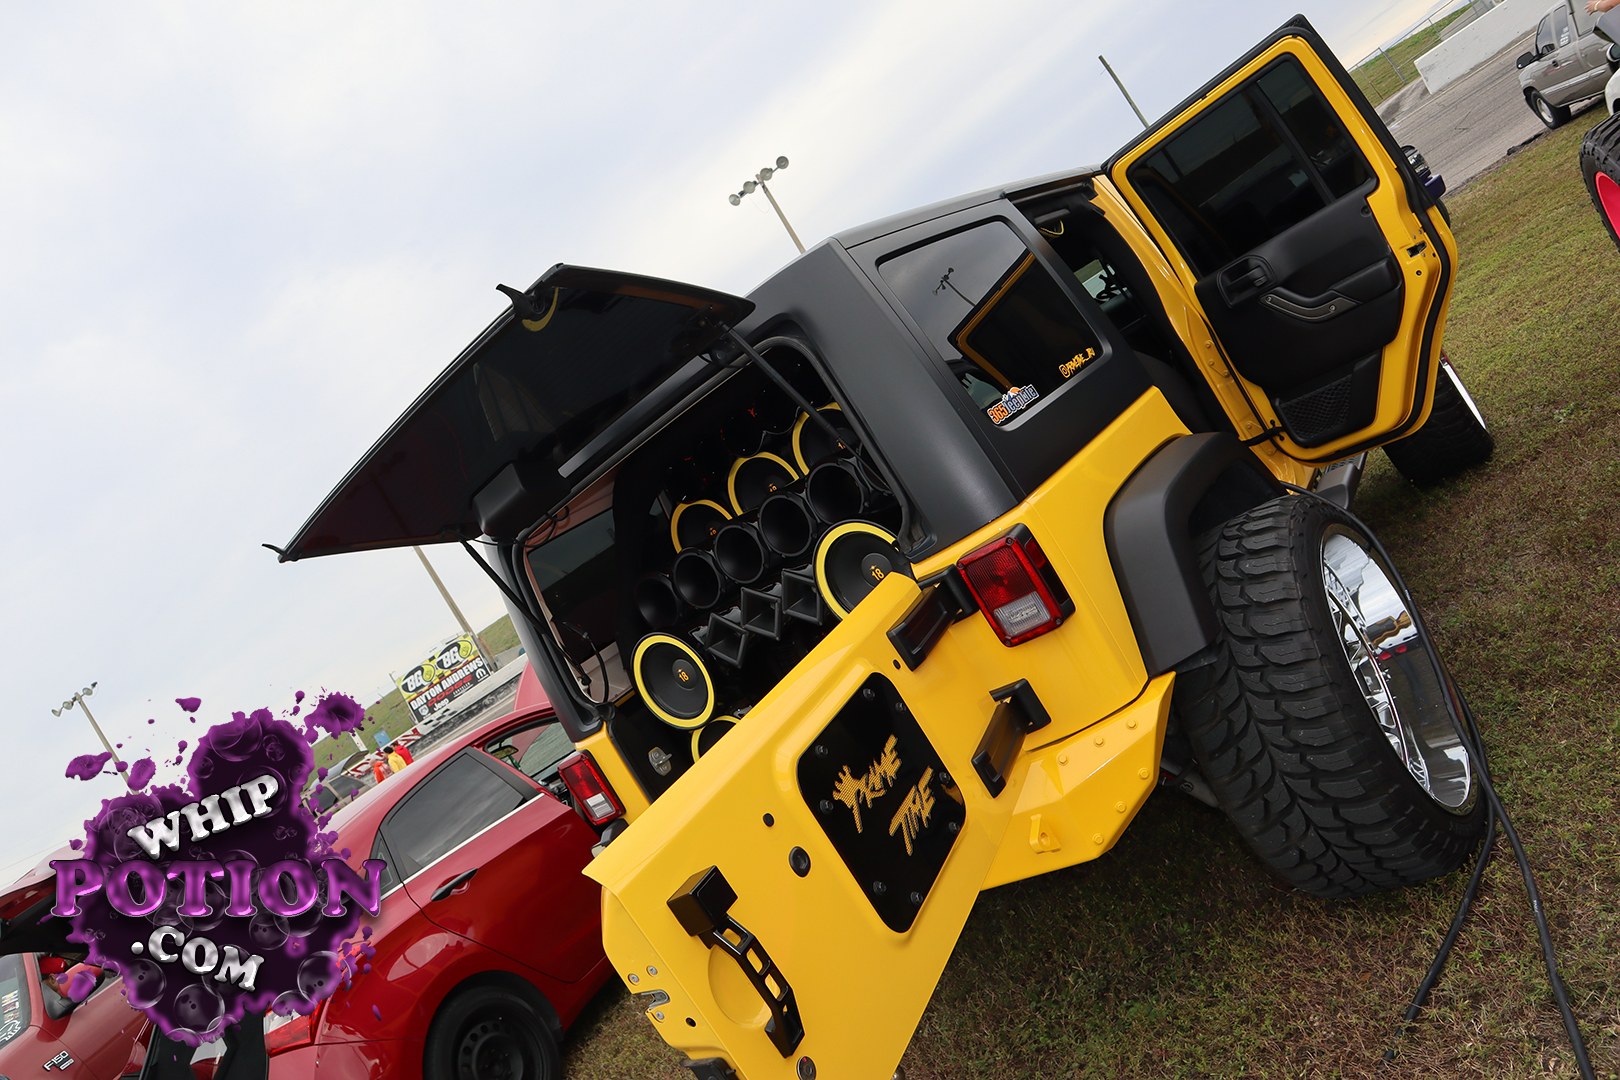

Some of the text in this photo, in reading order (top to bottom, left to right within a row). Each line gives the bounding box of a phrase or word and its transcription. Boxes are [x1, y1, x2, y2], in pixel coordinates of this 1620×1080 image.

[871, 568, 885, 581] 18
[679, 671, 689, 682] 18
[410, 658, 484, 710] DAYTON ANDREWS
[433, 698, 450, 711] Jeep
[889, 765, 935, 856] TIME
